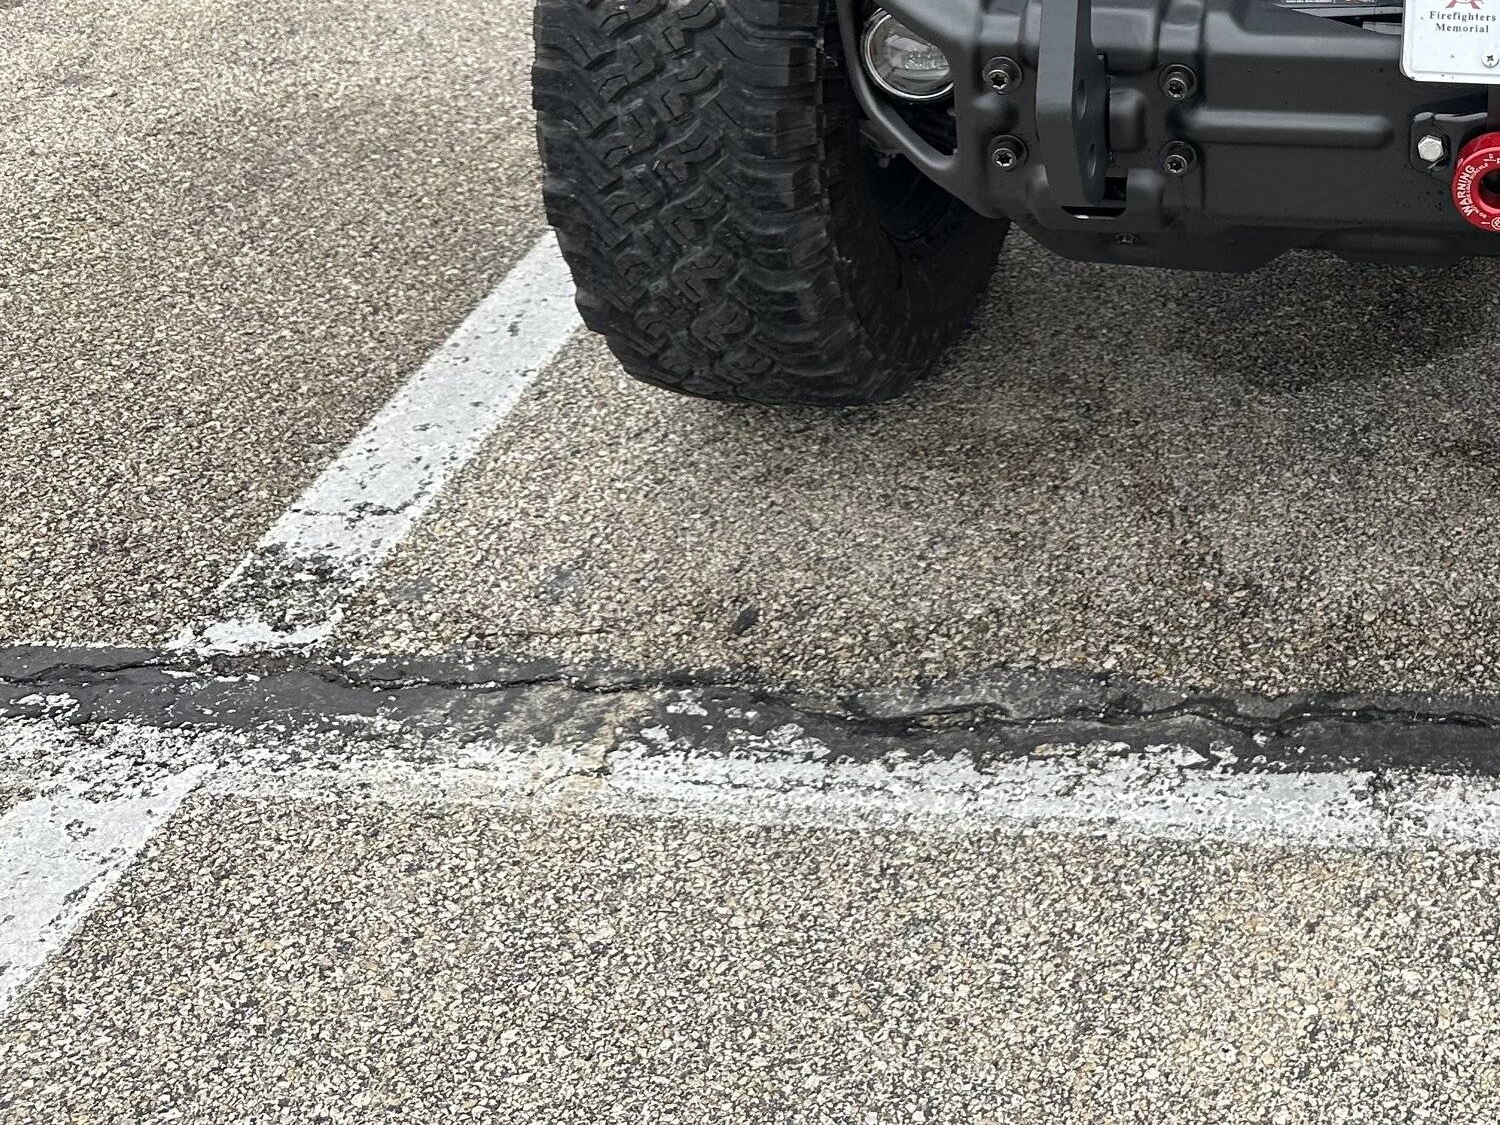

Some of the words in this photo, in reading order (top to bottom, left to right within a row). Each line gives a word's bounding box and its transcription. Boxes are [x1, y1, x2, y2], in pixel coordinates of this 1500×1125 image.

[1429, 10, 1497, 23] Firefighters
[1435, 23, 1489, 34] Memorial
[1456, 164, 1476, 217] WARNING
